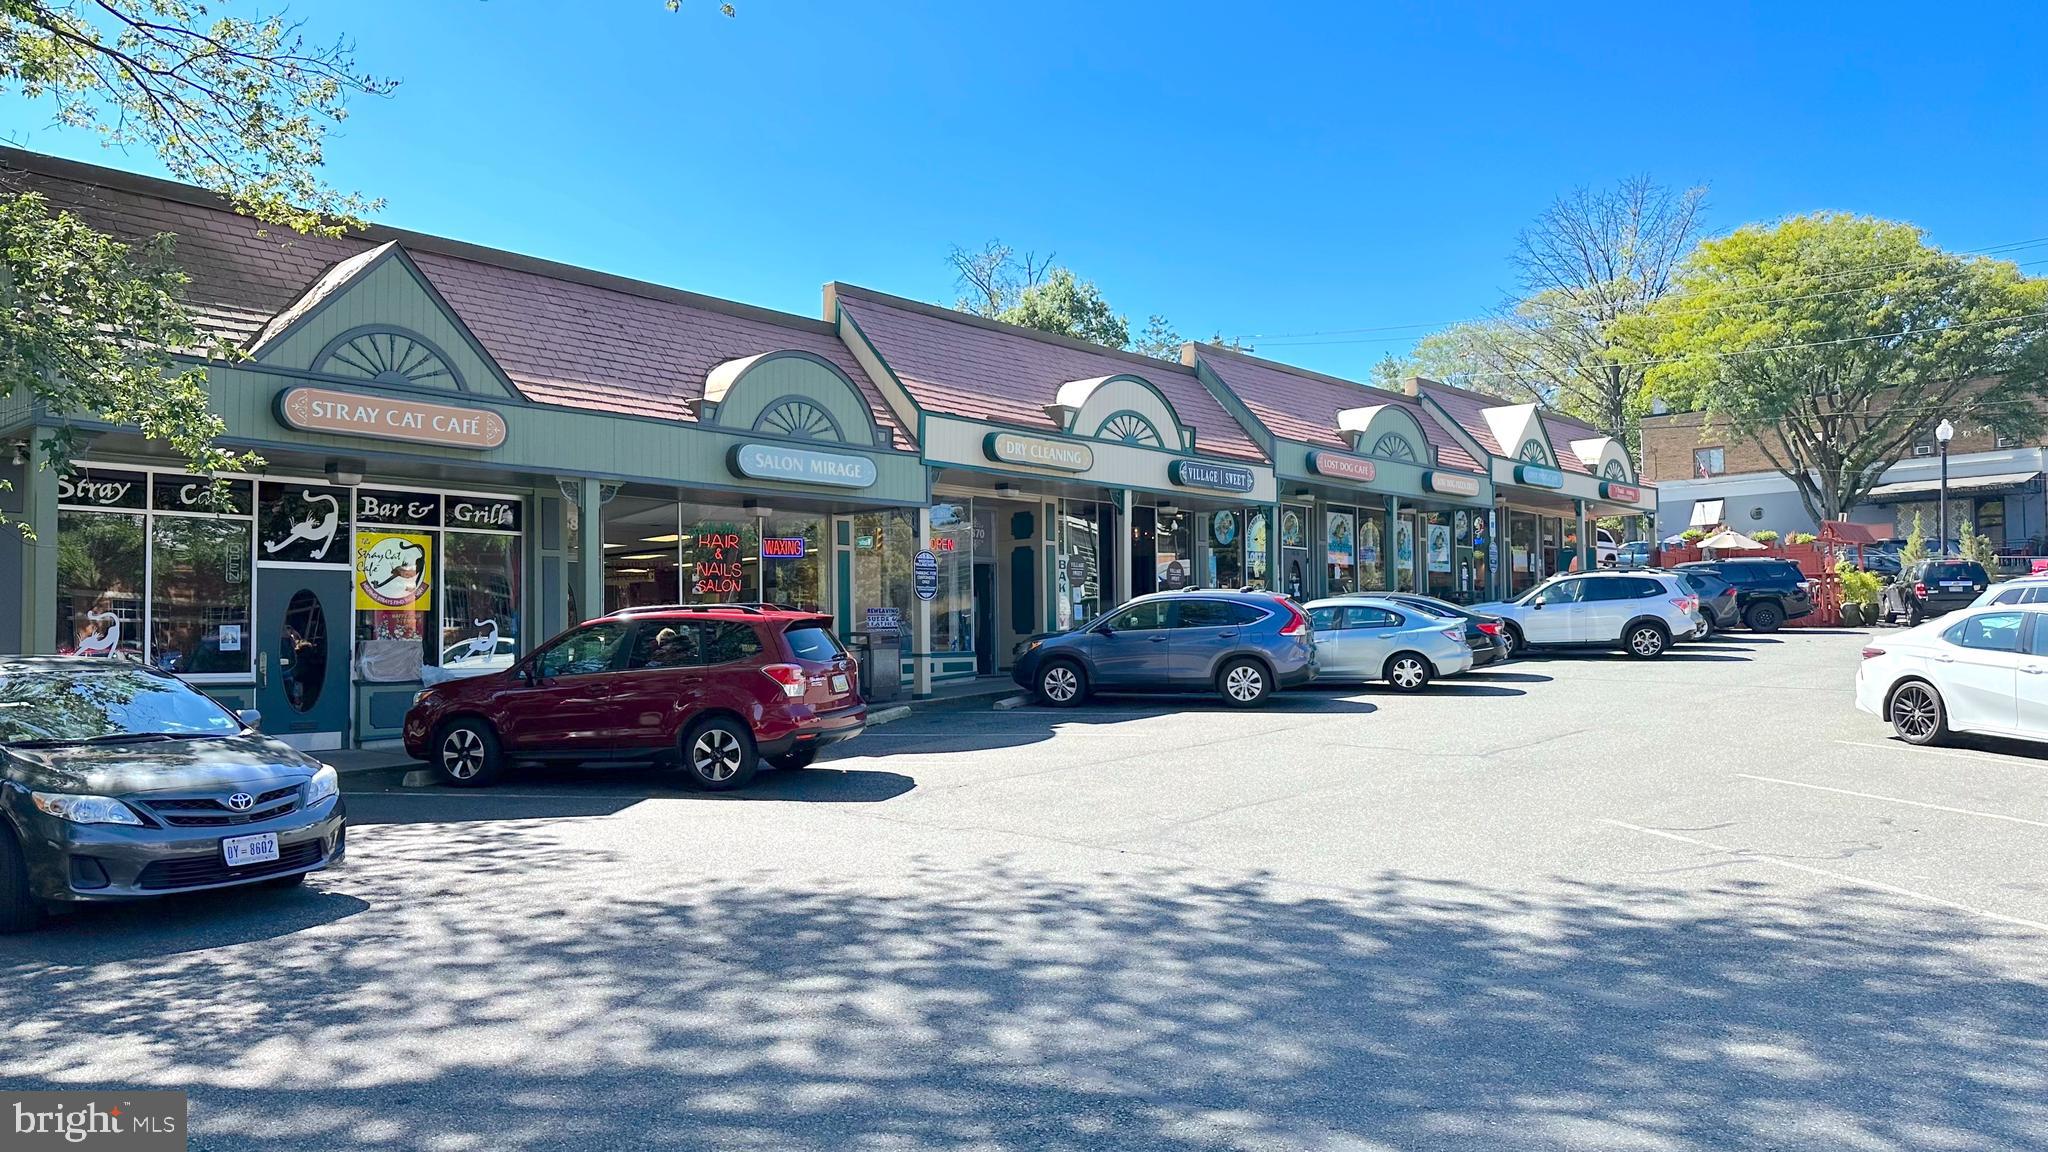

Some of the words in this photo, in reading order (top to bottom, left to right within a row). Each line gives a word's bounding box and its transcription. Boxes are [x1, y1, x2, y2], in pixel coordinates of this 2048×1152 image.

[312, 400, 380, 424] STRAY
[386, 410, 425, 429] CAT
[432, 415, 480, 435] CAFÉ
[1006, 441, 1027, 455] DRY
[1030, 445, 1081, 463] CLEANING
[755, 453, 804, 471] SALON
[810, 459, 862, 478] MIRAGE
[1324, 459, 1338, 470] LOST
[1340, 462, 1353, 473] DOG
[1188, 467, 1218, 483] VILLAGE
[1225, 472, 1246, 486] SWEET
[58, 474, 131, 504] Stray
[180, 484, 216, 506] Ca
[361, 496, 403, 517] Bar
[408, 502, 434, 518] &
[454, 503, 508, 525] Grill
[698, 534, 739, 549] HAIR
[764, 540, 801, 555] WAXING
[930, 538, 954, 550] OPEN
[357, 547, 384, 561] Stray
[384, 549, 401, 560] Cat
[714, 547, 723, 560] &
[696, 561, 742, 578] NAILS
[697, 579, 742, 592] SALON
[250, 840, 274, 855] 8602
